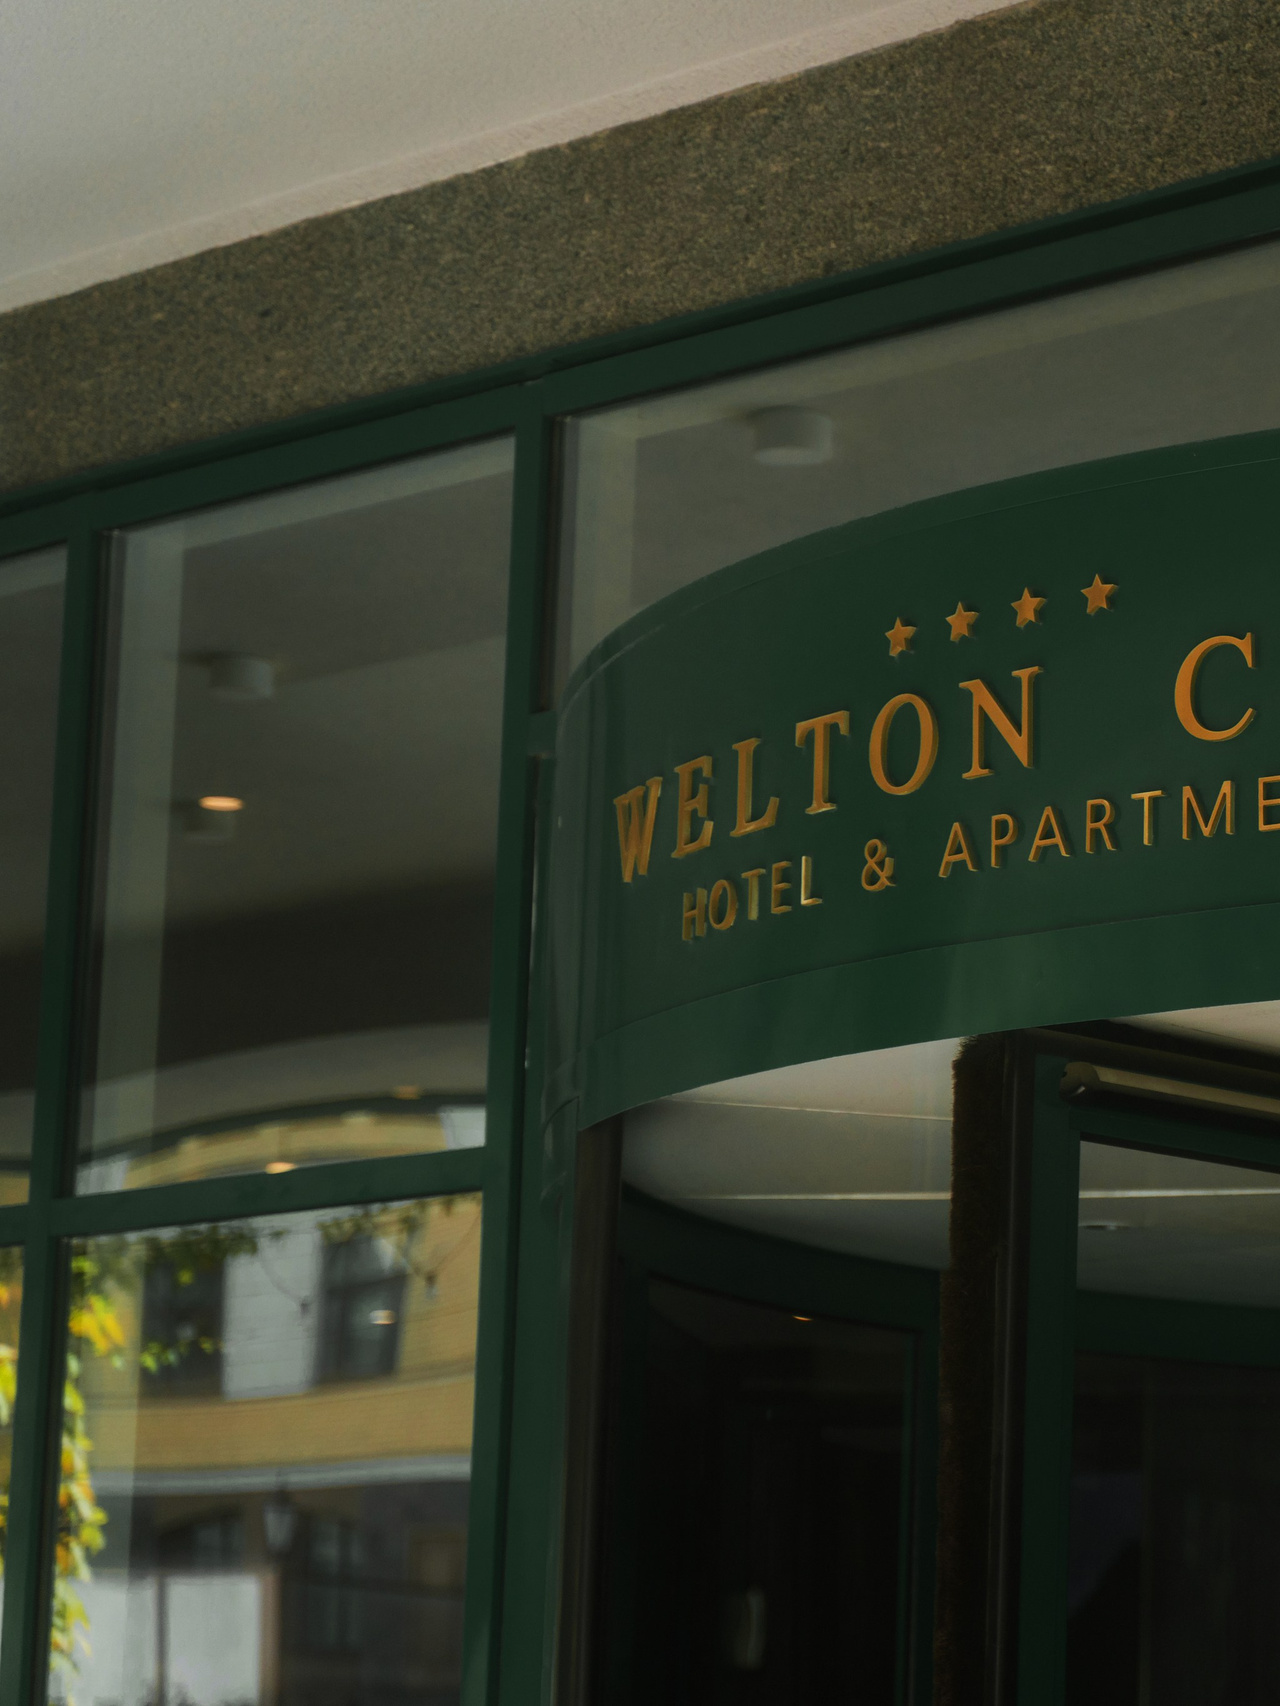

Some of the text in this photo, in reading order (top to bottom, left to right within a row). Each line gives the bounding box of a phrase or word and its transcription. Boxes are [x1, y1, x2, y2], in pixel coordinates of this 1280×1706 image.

[612, 664, 1045, 883] WELTON
[681, 855, 823, 941] HOTEL
[860, 838, 896, 892] &
